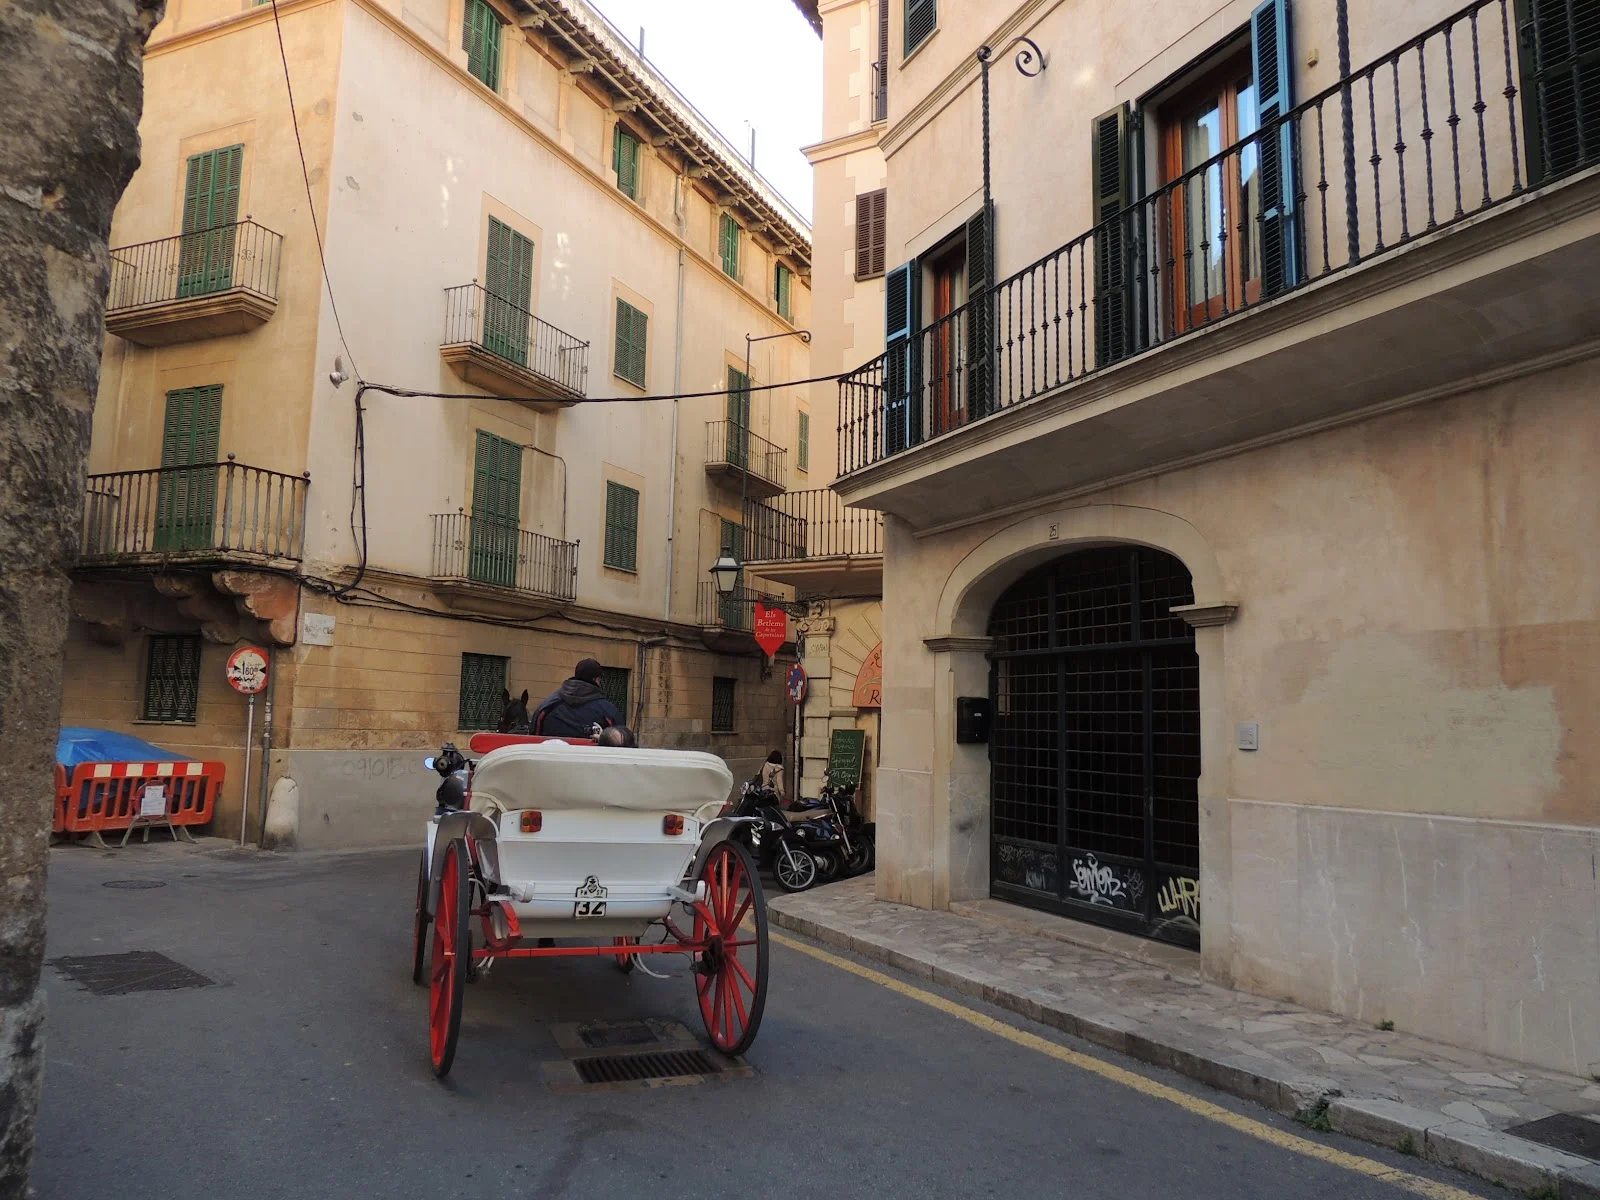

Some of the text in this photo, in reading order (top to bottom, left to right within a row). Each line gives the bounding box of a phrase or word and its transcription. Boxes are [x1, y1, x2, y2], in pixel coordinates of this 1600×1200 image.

[765, 610, 776, 618] Els
[757, 618, 785, 627] Betlems
[578, 896, 603, 915] 32
